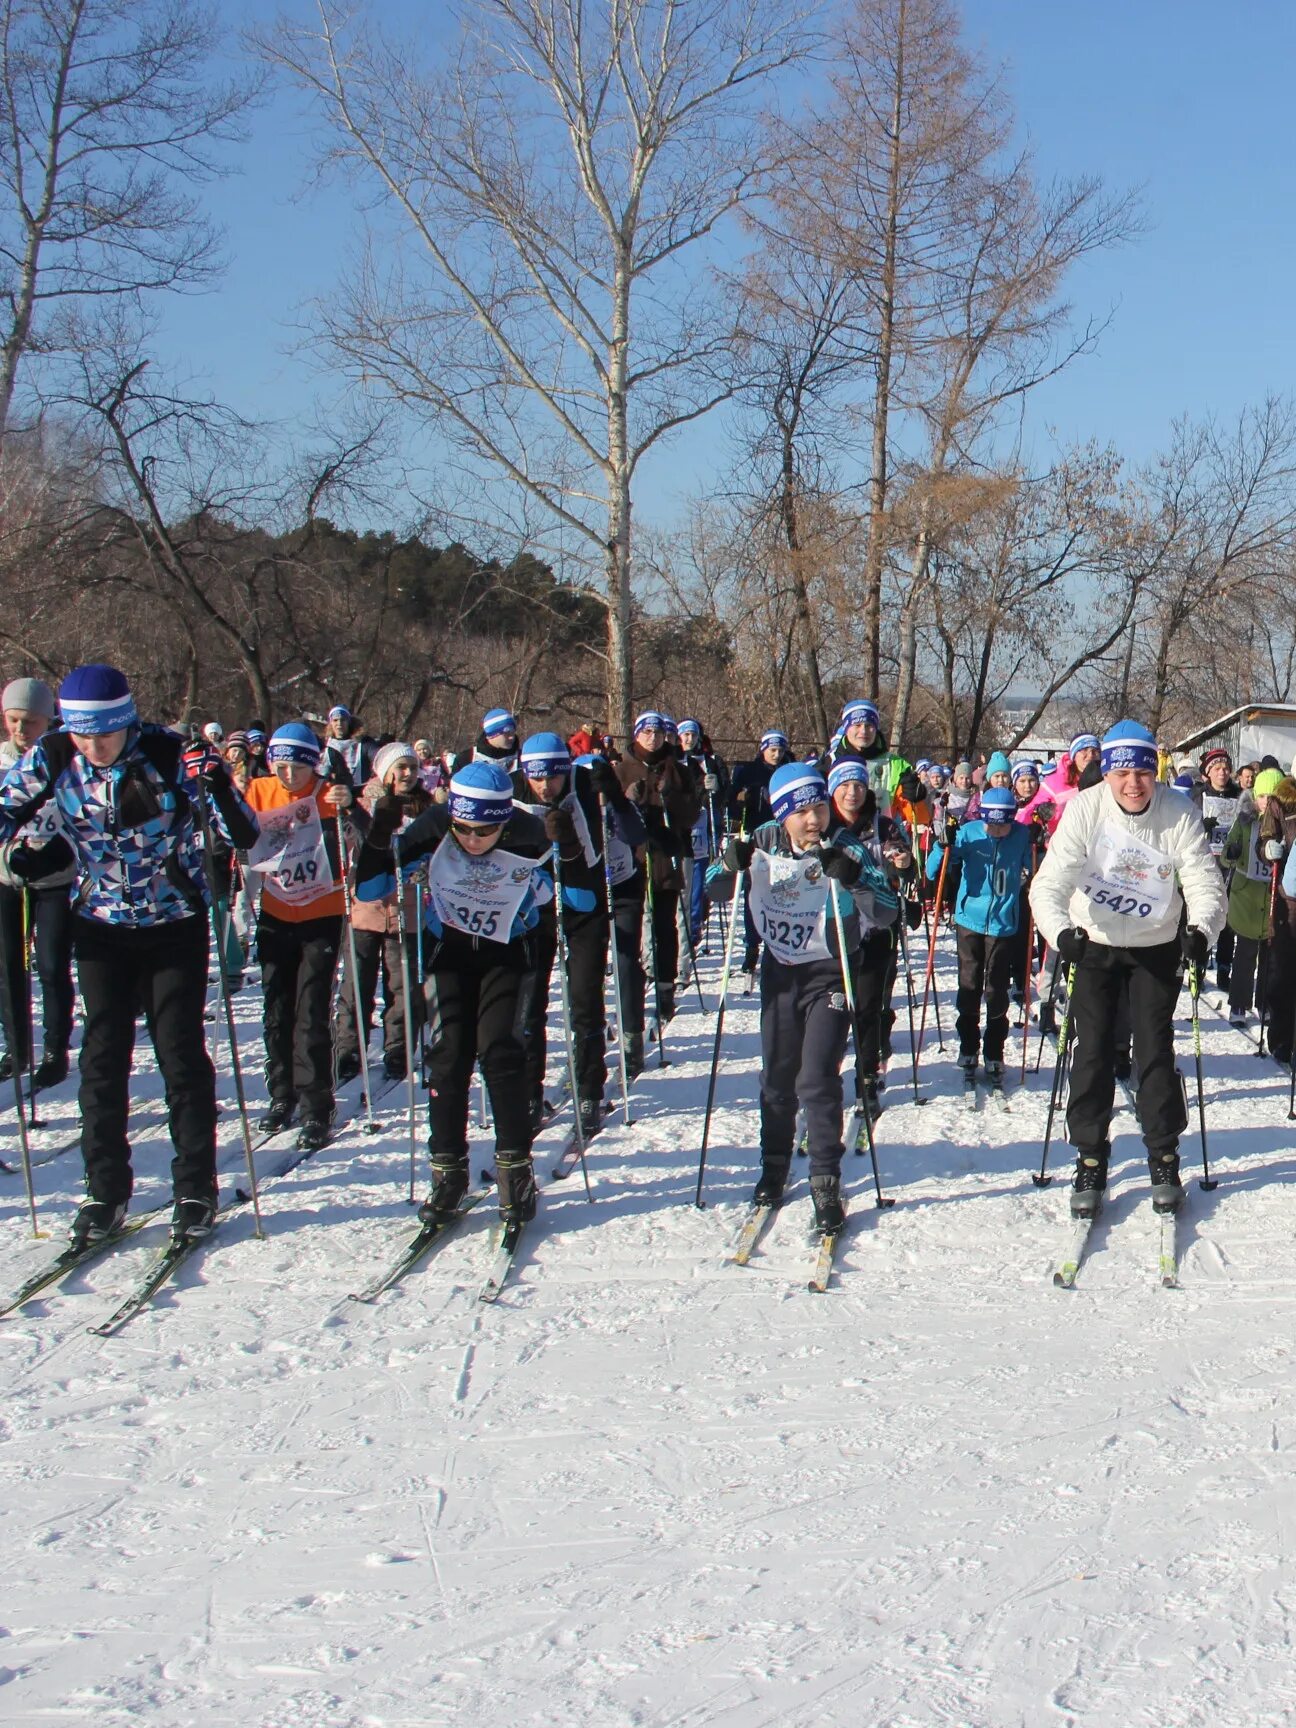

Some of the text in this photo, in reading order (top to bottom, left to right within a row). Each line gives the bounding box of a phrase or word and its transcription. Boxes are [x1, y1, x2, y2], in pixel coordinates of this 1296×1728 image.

[1110, 760, 1137, 770] 2016
[451, 809, 475, 820] 2016
[1083, 884, 1152, 918] 15429
[760, 910, 815, 950] 15237
